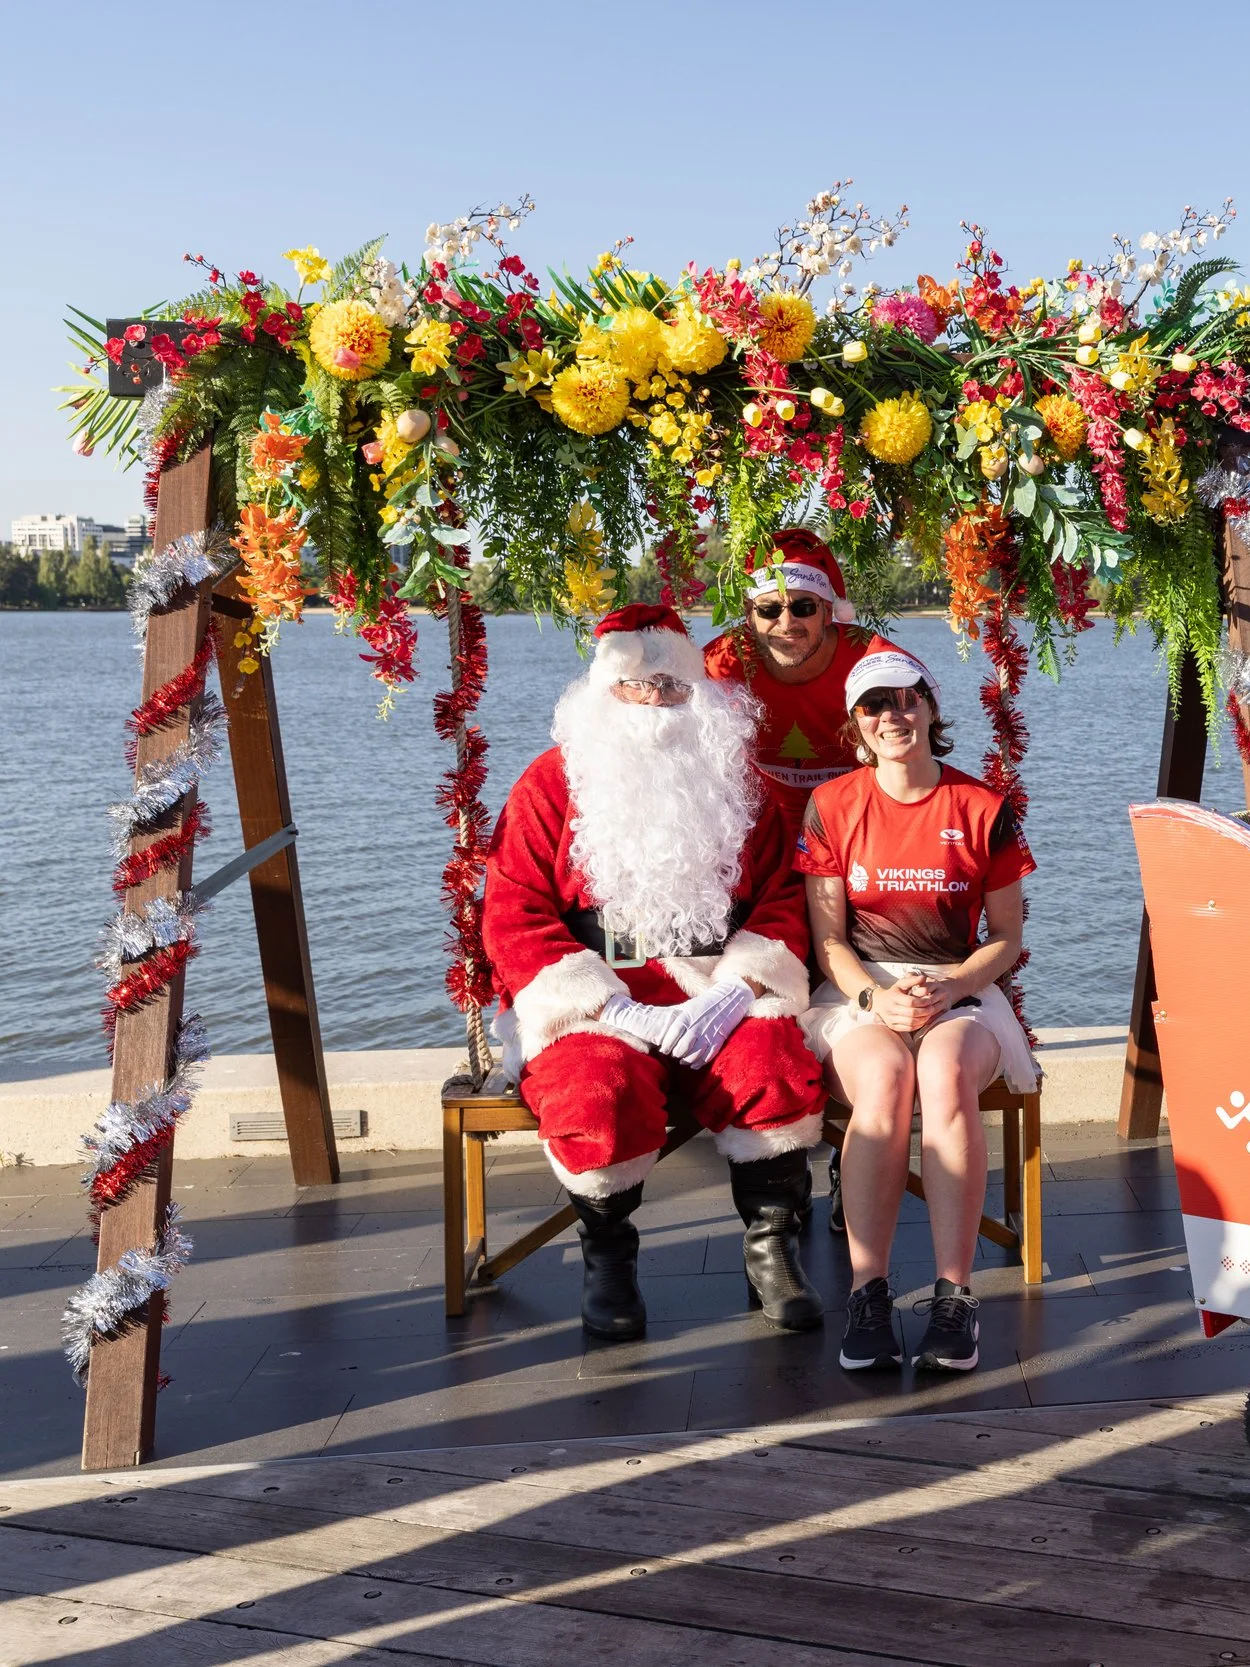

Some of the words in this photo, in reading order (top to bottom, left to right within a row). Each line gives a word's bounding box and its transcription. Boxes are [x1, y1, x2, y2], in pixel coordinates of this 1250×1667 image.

[791, 773, 824, 784] TRAIL
[876, 868, 946, 880] VIKINGS
[875, 880, 970, 892] TRIATHLON
